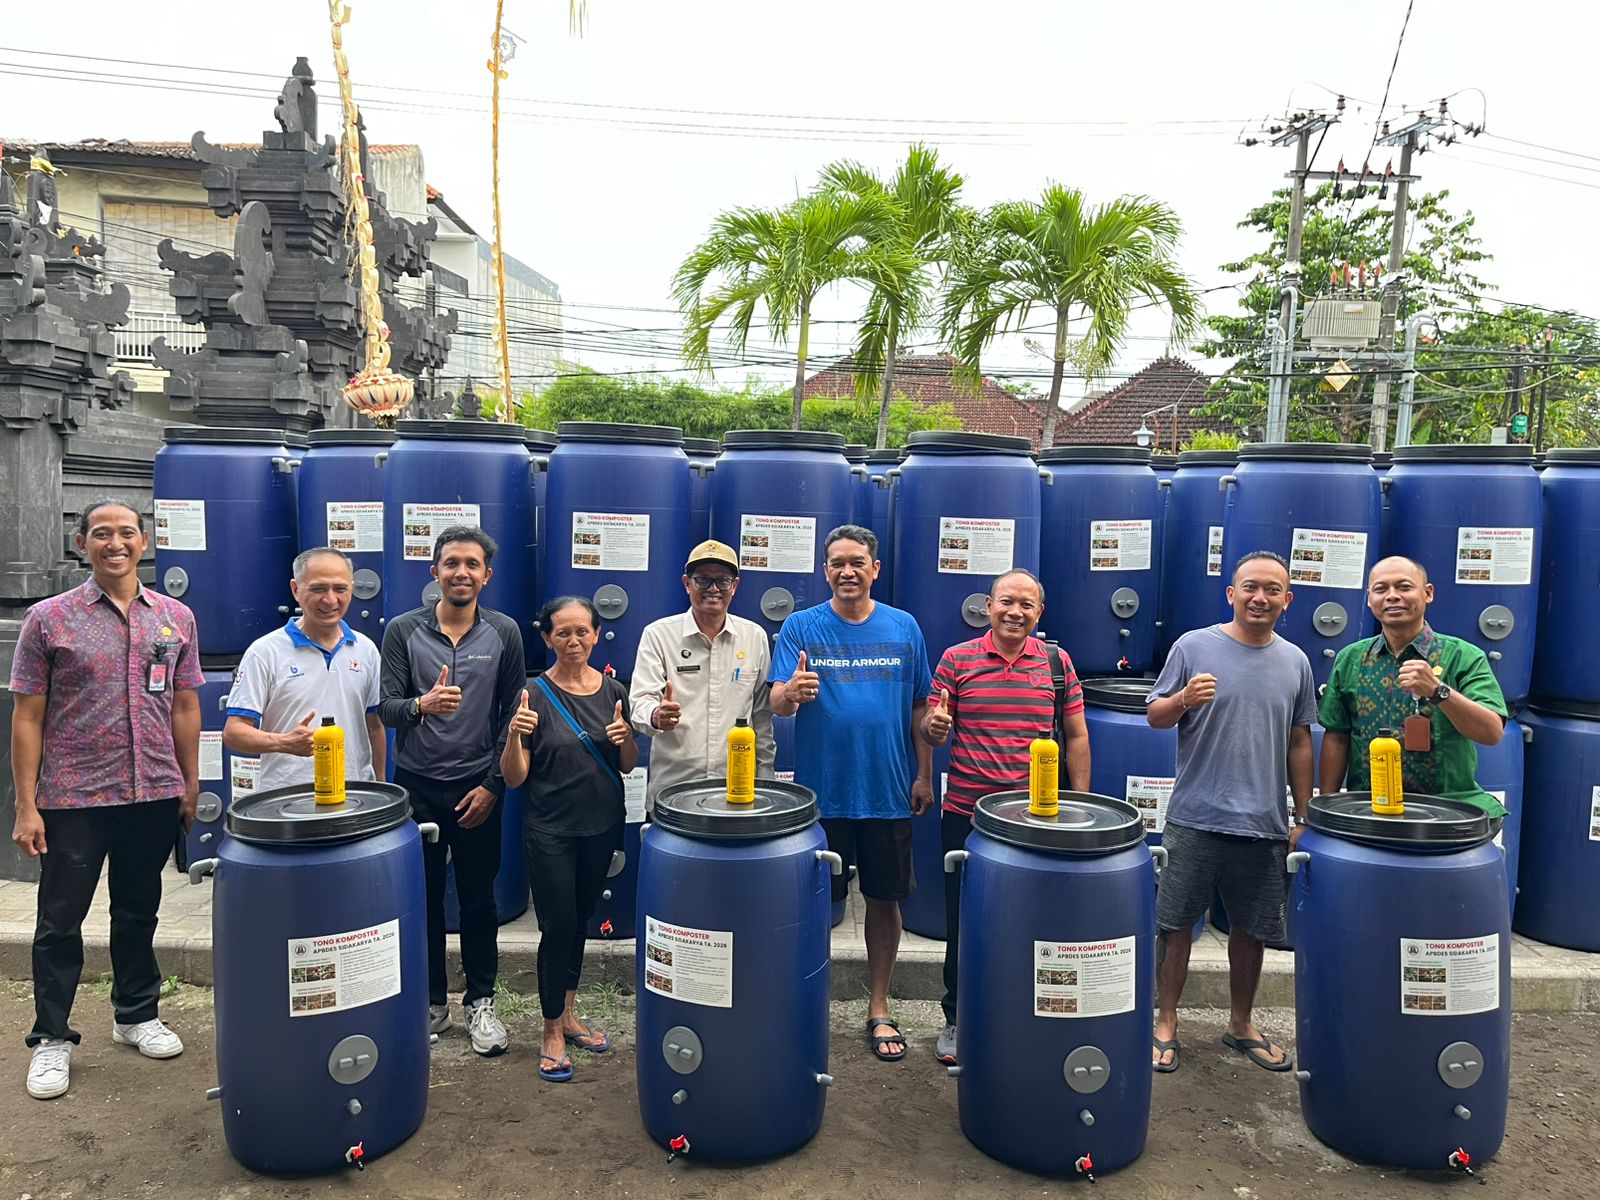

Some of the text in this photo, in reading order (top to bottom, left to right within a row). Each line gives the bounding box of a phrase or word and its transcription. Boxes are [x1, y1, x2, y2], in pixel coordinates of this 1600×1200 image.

[810, 658, 901, 667] UNDER ARMOUR
[731, 743, 752, 752] EM4
[658, 924, 710, 940] TONG KOMPOSTER
[313, 929, 379, 947] TONG KOMPOSTER
[658, 932, 674, 942] APBDES
[675, 935, 703, 946] SIDAKARYA
[338, 940, 372, 951] SIDAKARYA
[1078, 943, 1117, 952] KOMPOSTER
[1446, 941, 1484, 949] KOMPOSTER
[1449, 948, 1478, 956] SIDAKARYA
